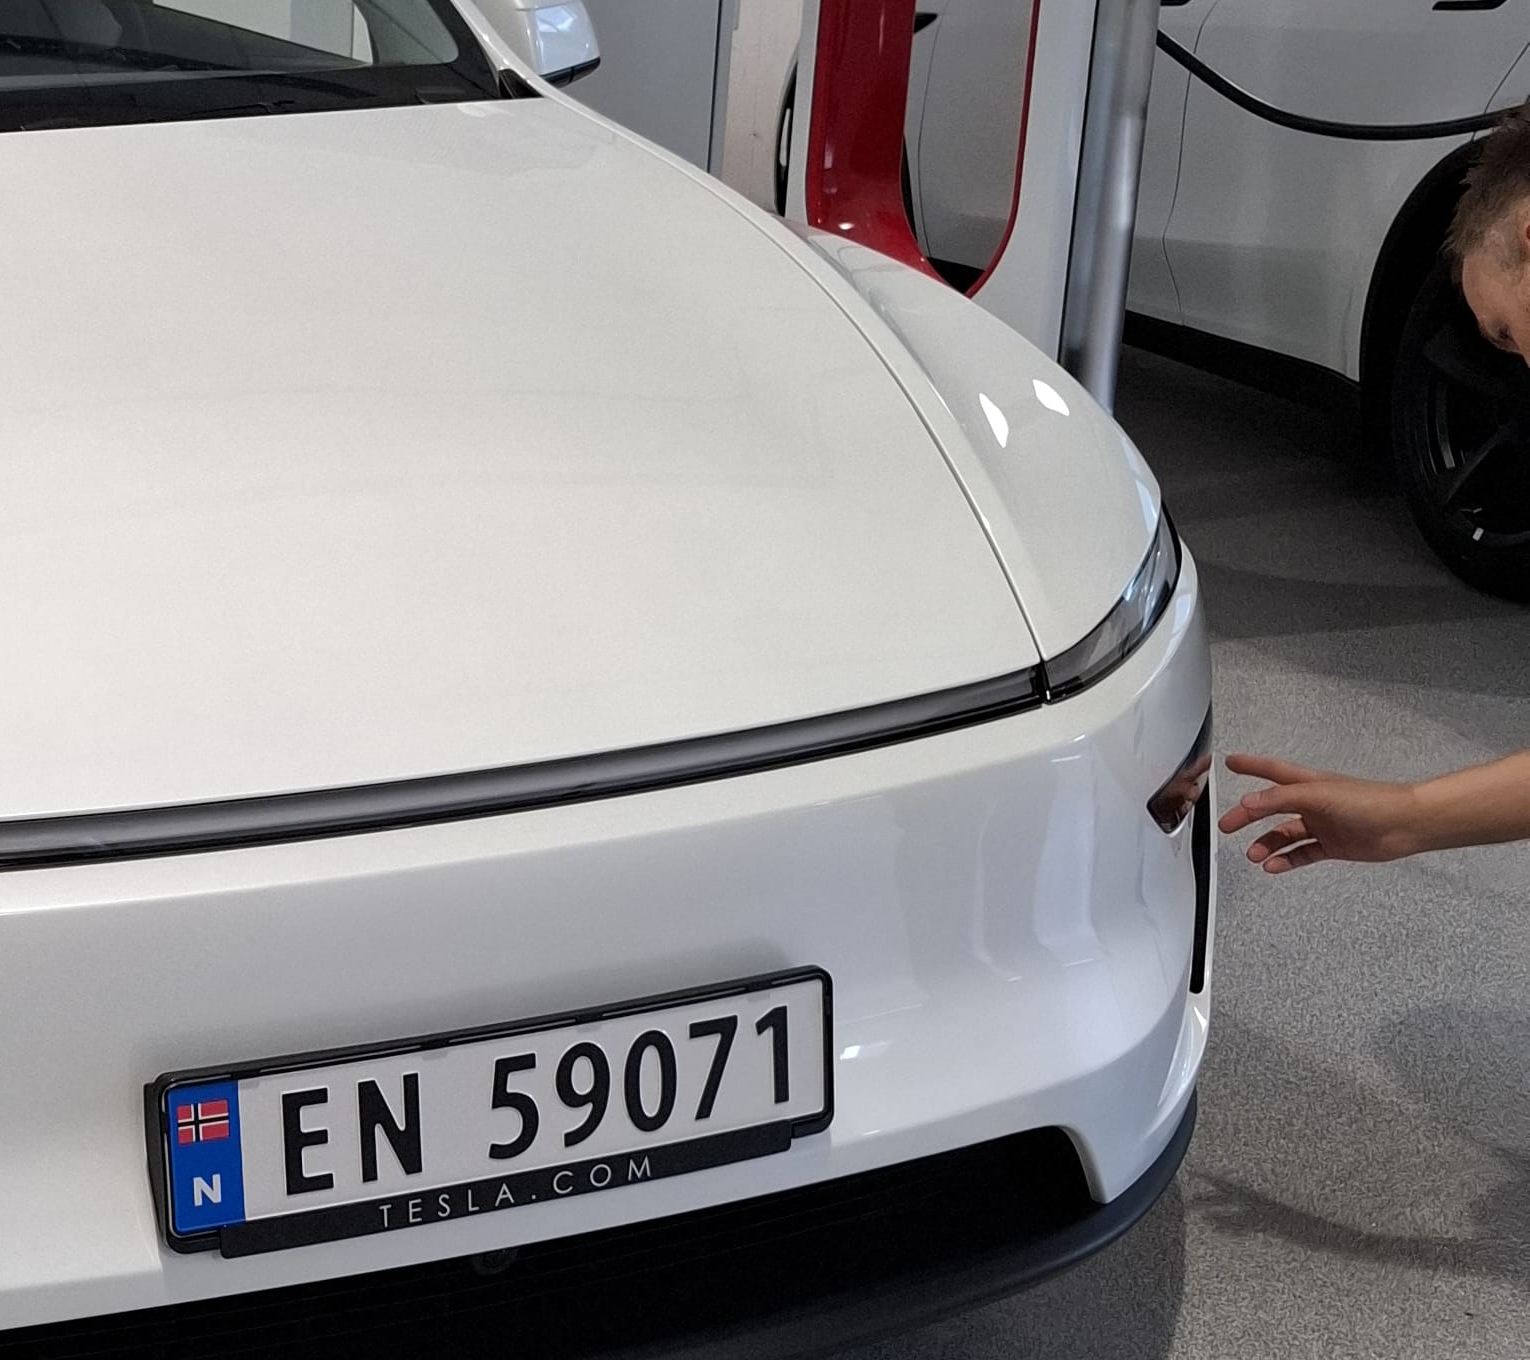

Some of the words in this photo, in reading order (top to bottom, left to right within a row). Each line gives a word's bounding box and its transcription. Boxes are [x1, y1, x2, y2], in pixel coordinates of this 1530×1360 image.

[280, 1071, 424, 1196] EN
[487, 1005, 790, 1160] 59071
[193, 1172, 222, 1207] N
[378, 1154, 653, 1229] TESLA.COM
